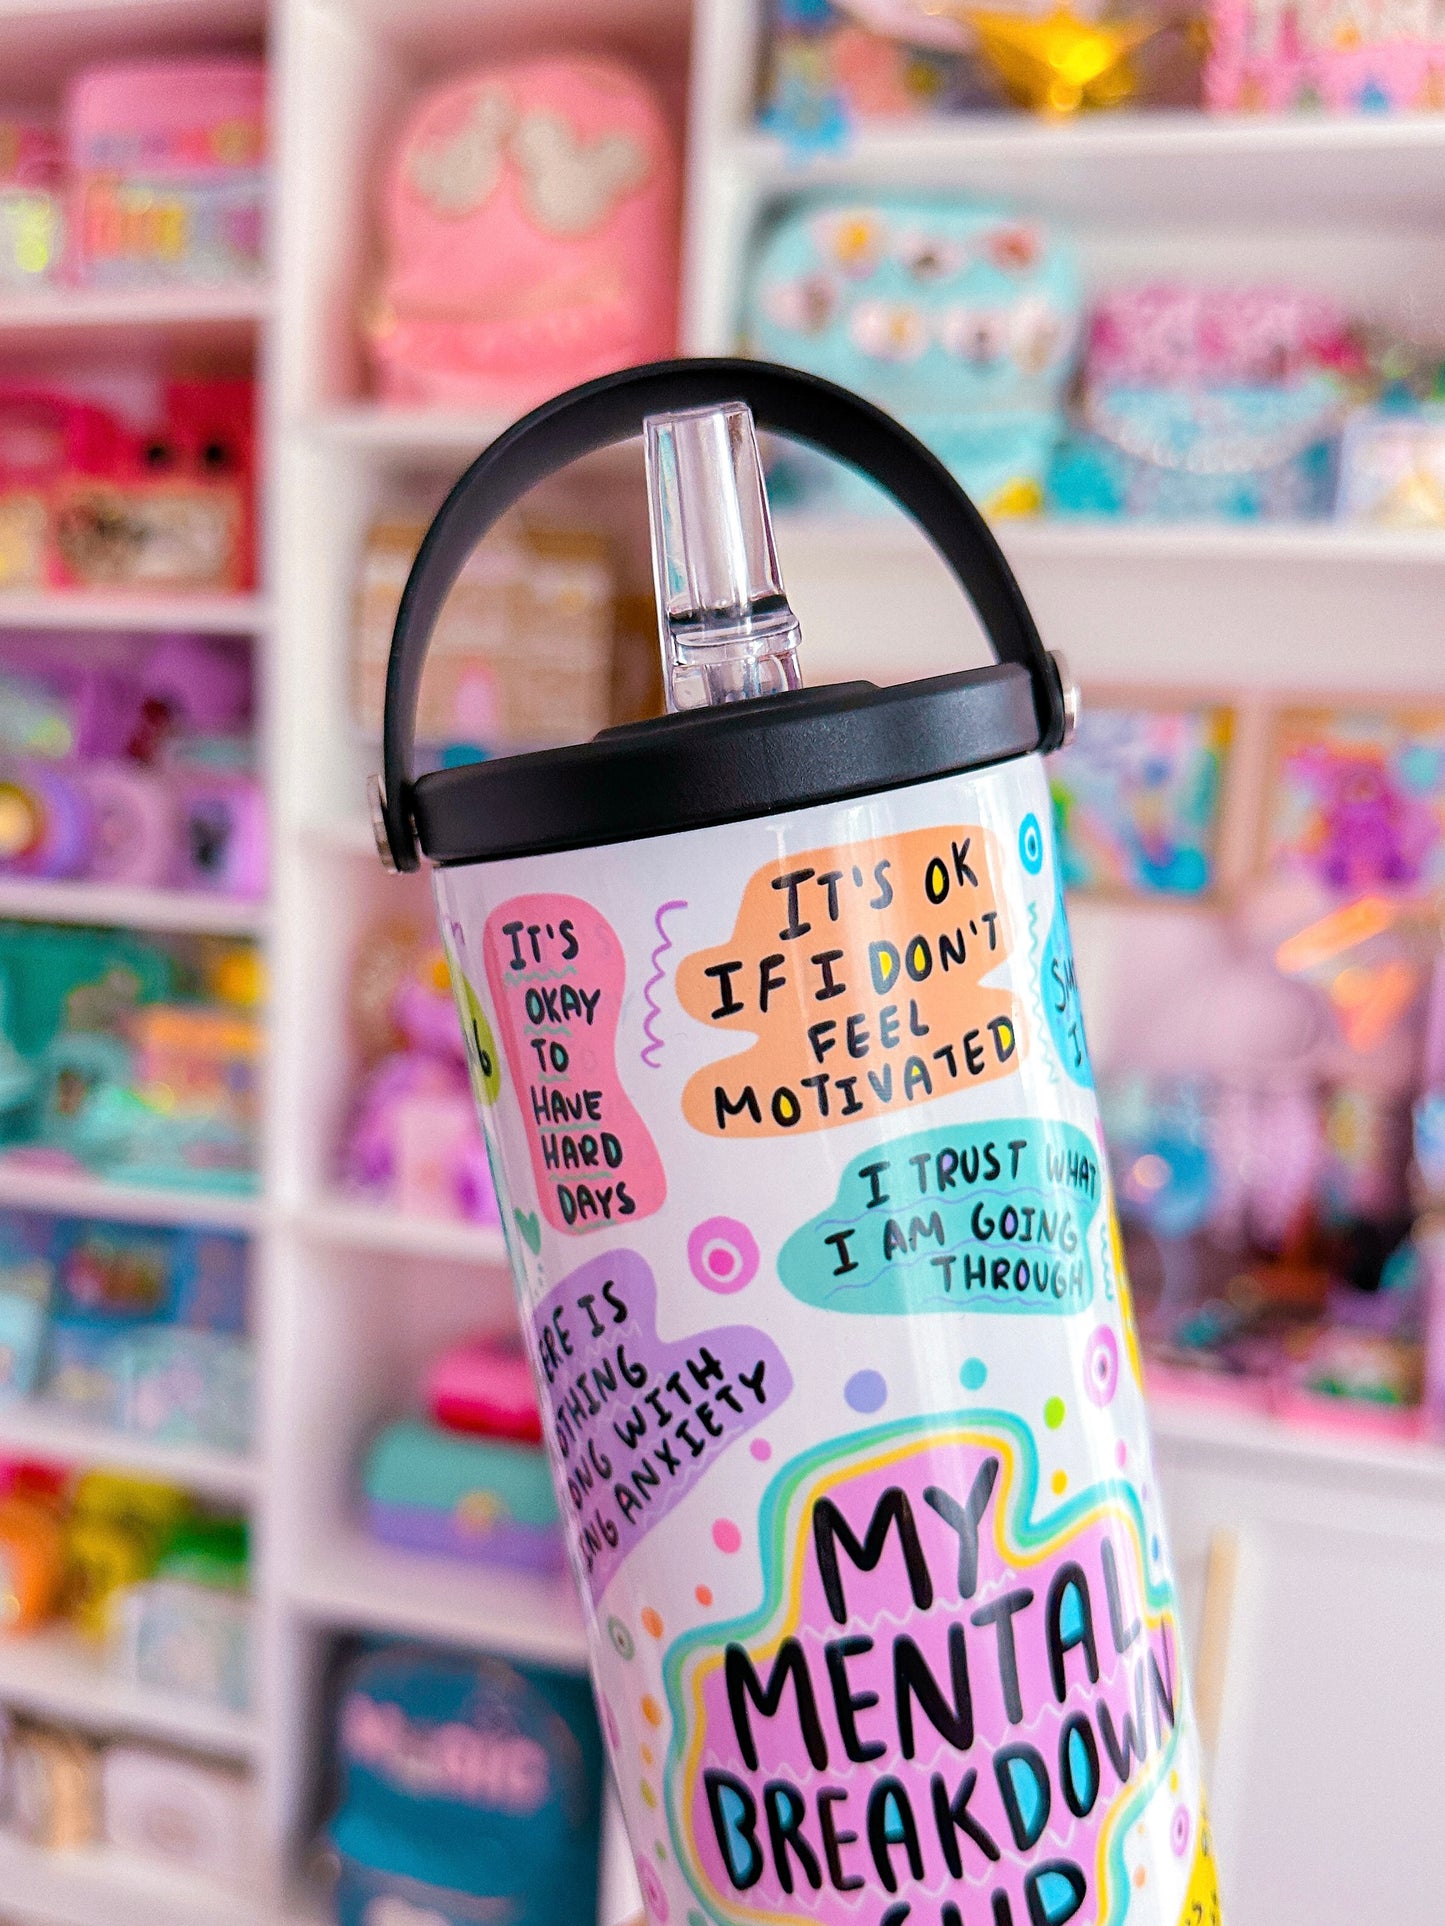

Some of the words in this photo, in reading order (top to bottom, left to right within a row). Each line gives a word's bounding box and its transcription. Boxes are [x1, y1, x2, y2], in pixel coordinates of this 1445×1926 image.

[772, 859, 894, 941] IT'S
[925, 838, 979, 905] OK
[502, 919, 579, 970] IT'S
[704, 954, 786, 1019] IF
[810, 949, 846, 1000] I
[868, 911, 998, 995] DON'T
[525, 984, 601, 1025] OKAY
[808, 999, 930, 1063] FEEL
[532, 1038, 570, 1073] TO
[715, 1016, 1016, 1129] MOTIVATED
[530, 1086, 603, 1125] HAVE
[542, 1132, 623, 1170] HARD
[858, 1161, 890, 1208] I
[909, 1140, 1027, 1194] TRUST
[1046, 1142, 1097, 1199] WHAT
[557, 1181, 637, 1225] DAYS
[824, 1229, 858, 1276] I
[883, 1211, 945, 1261] AM
[971, 1201, 1078, 1255] GOING
[577, 1280, 628, 1337] IS
[930, 1253, 1084, 1299] THROUGH
[556, 1344, 648, 1458] OTHING
[567, 1437, 613, 1510] ONG
[614, 1347, 724, 1449] WITH
[614, 1360, 766, 1524] ANXIETY
[812, 1456, 999, 1624] MY
[724, 1536, 1140, 1772] MENTAL
[703, 1614, 1175, 1894] BREAKDOWN
